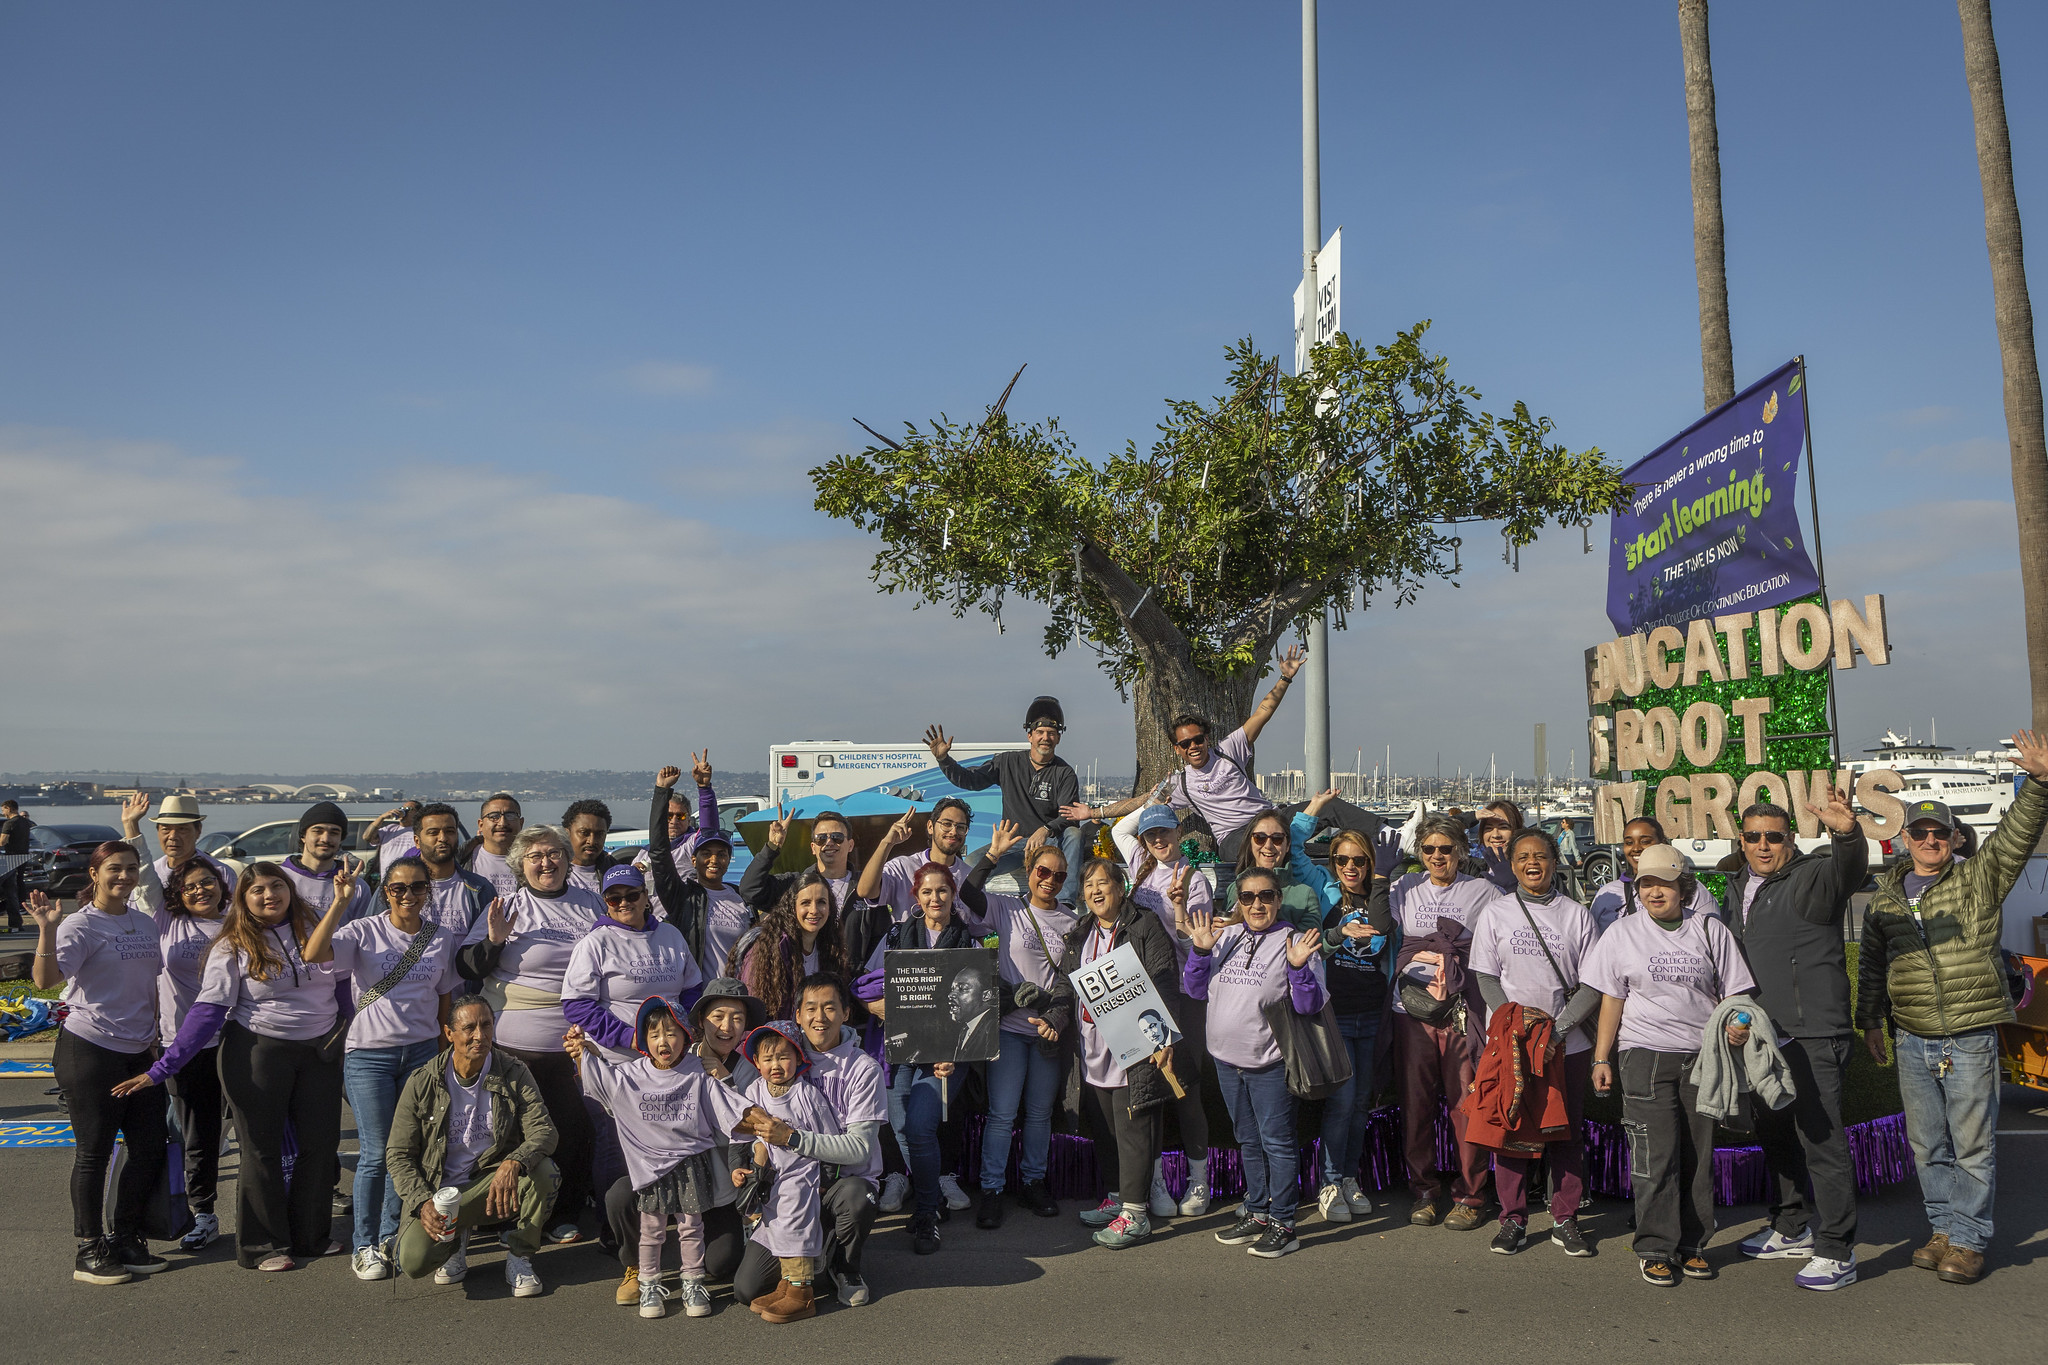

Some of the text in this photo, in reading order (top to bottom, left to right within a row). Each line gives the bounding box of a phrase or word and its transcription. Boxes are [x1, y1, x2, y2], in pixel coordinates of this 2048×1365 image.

[1318, 274, 1336, 311] VISIT
[1317, 303, 1337, 341] THEM
[1634, 429, 1764, 518] There is never a wrong time to
[1627, 468, 1771, 571] start learning.
[1664, 536, 1739, 582] THE TIME IS NOW
[1665, 608, 1690, 627] COLLEGE
[1690, 604, 1701, 619] OF
[1701, 588, 1746, 615] CONTINUING
[1746, 572, 1790, 600] EDUCATION
[1616, 697, 1773, 771] ROOT
[839, 753, 884, 761] CHILDREN'S
[1906, 786, 1993, 798] ADVENTURE HORNBLOWER
[1655, 769, 1906, 840] GROWS
[1418, 905, 1450, 913] COLLEGE
[121, 951, 158, 960] EDUCATION
[1650, 957, 1701, 965] COLLEGE OF
[630, 966, 677, 975] CONTINUING
[1648, 964, 1705, 975] CONTINUING
[634, 975, 676, 983] EDUCATION
[1220, 975, 1262, 987] EDUCATION
[1652, 974, 1702, 983] EDUCATION
[1094, 980, 1147, 1017] PRESENT
[642, 1092, 693, 1101] COLLEGE OF
[639, 1102, 696, 1112] CONTINUING
[642, 1112, 693, 1121] EDUCATION
